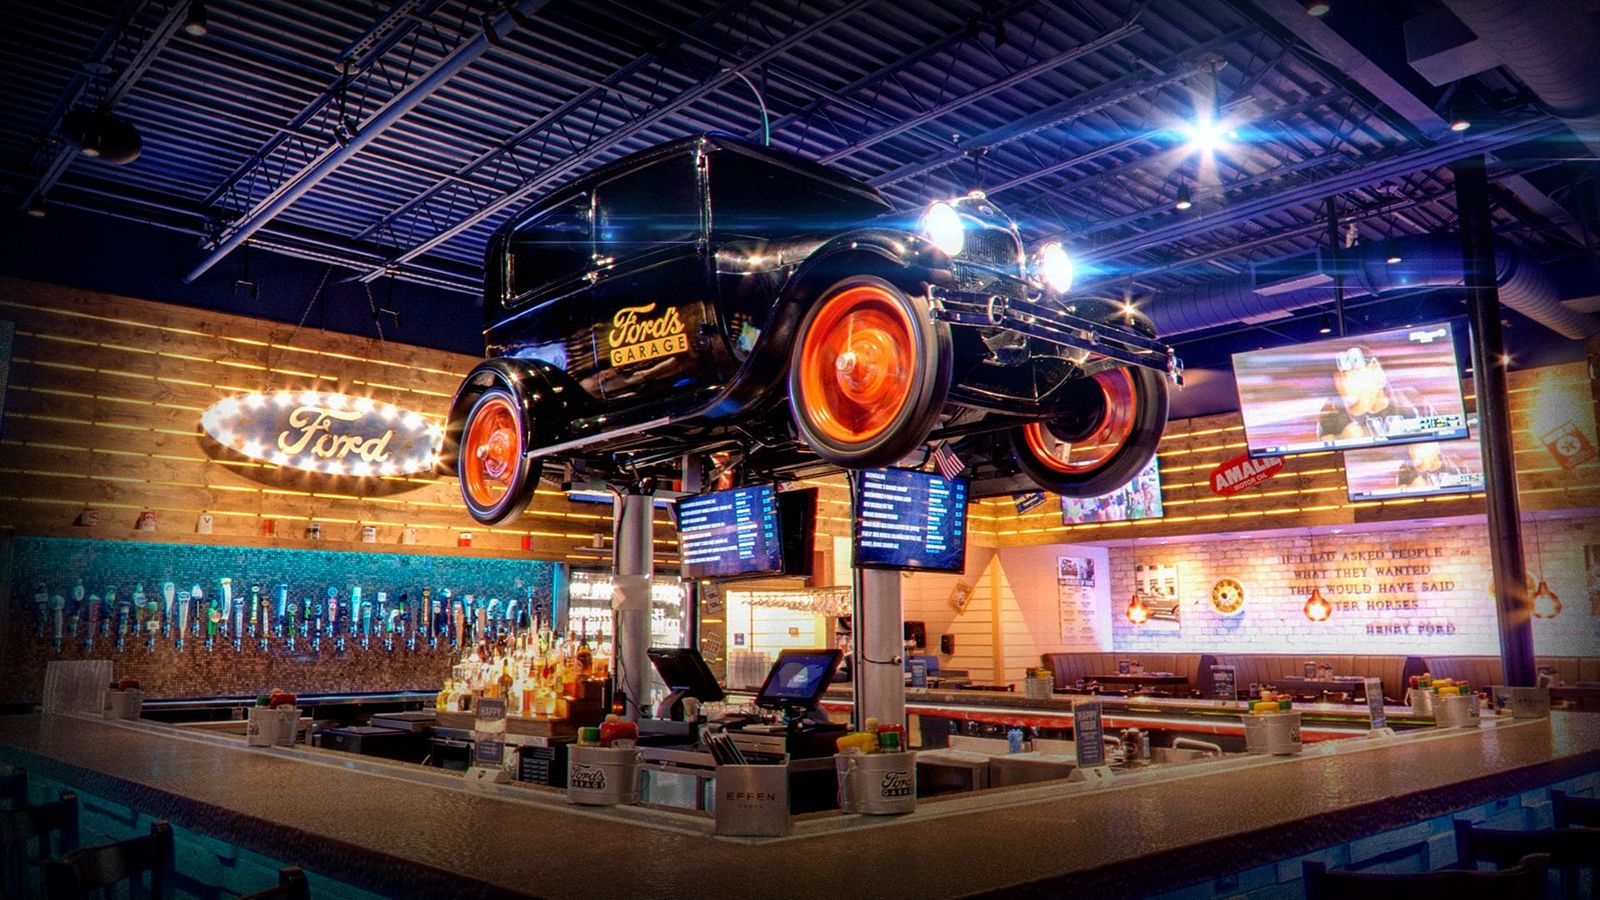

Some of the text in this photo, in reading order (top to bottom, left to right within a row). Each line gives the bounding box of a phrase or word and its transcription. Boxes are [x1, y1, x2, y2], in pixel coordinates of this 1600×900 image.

[609, 303, 685, 347] Ford's
[613, 337, 685, 363] GARAGE
[278, 407, 393, 462] Ford
[1234, 471, 1269, 490] MOTOR OIL
[1282, 554, 1294, 564] IF
[1310, 552, 1336, 562] HAD
[1343, 551, 1384, 561] ASKED
[1392, 548, 1443, 559] PEOPLE
[1294, 565, 1431, 579] WHAT THEY WANTED
[1289, 581, 1455, 595] THE WOULD HAVE SAID
[1367, 600, 1418, 610] HORSES
[1366, 624, 1456, 634] HENRY FORD
[726, 792, 775, 801] EFFEN
